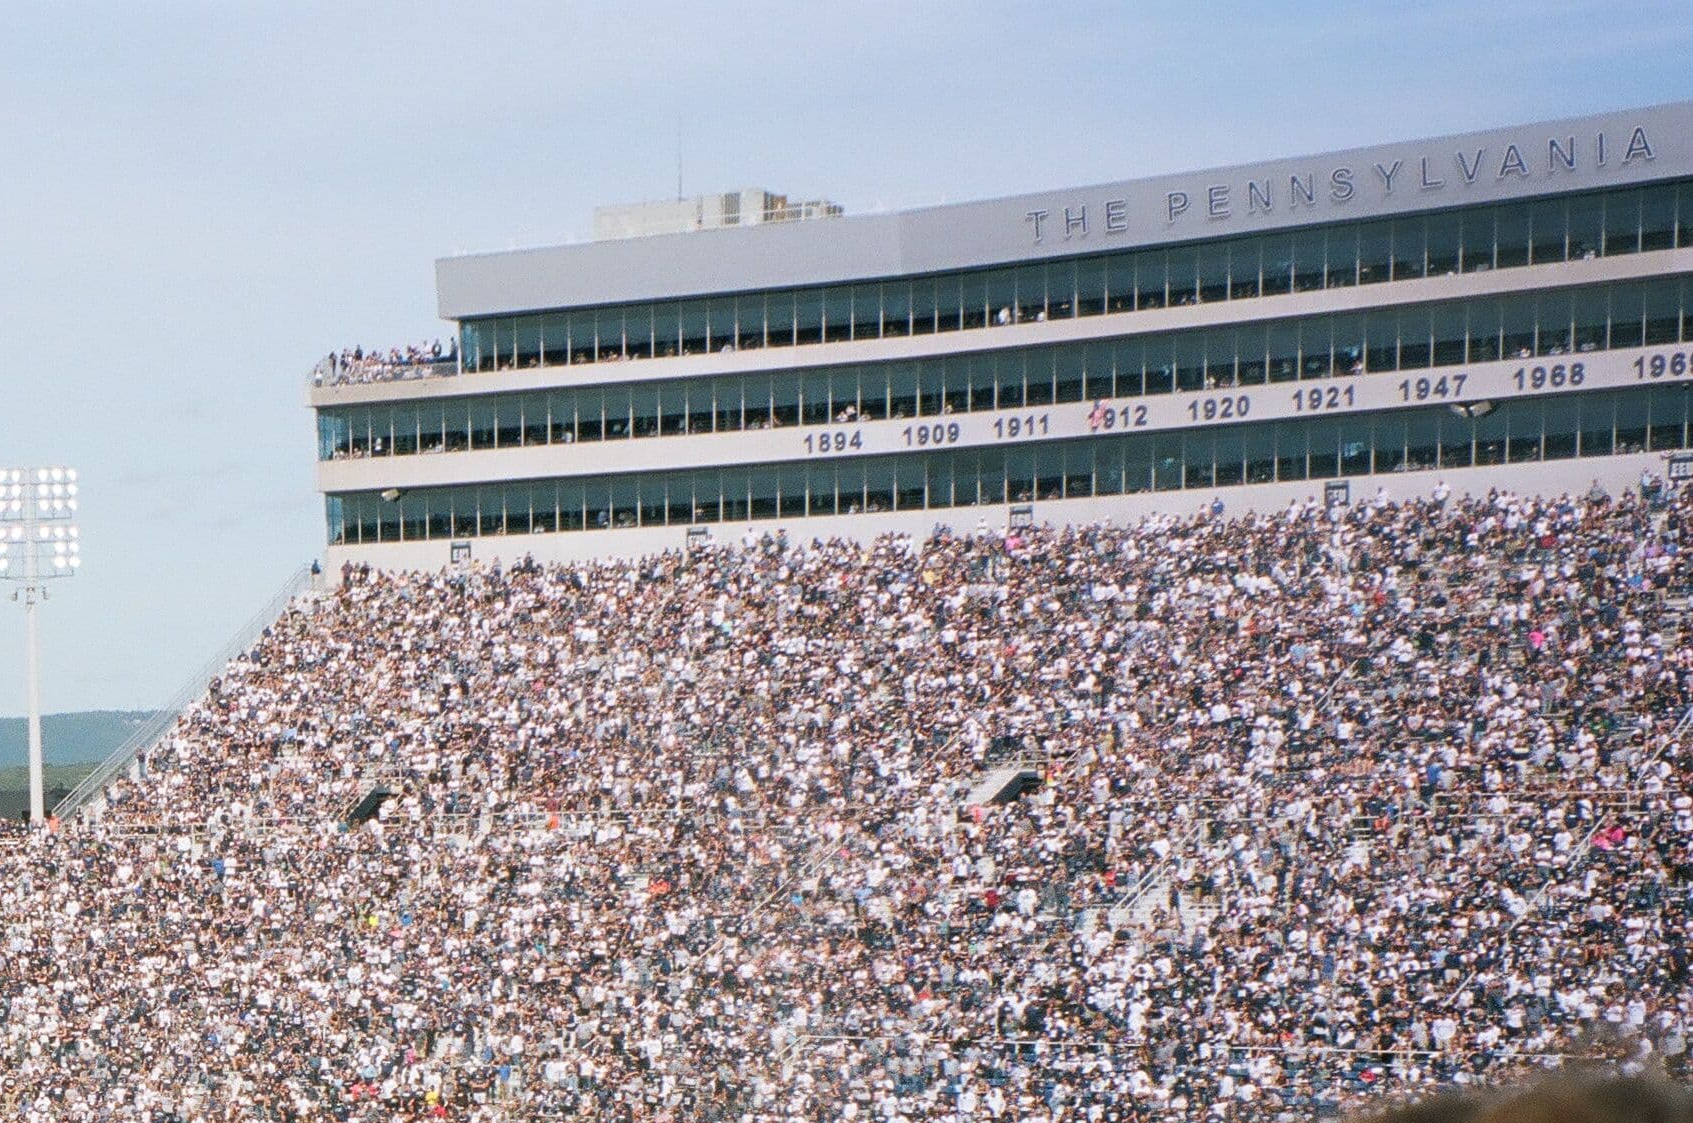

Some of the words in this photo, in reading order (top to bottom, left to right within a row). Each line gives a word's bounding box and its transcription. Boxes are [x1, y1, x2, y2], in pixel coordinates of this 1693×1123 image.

[1026, 199, 1128, 243] THE
[1166, 125, 1656, 226] PENNSYLVANIA
[1398, 374, 1468, 401] 1947
[1513, 362, 1585, 391] 1968
[1187, 395, 1250, 421] 1920
[1292, 385, 1356, 412] 1921
[903, 422, 961, 447] 1909
[994, 414, 1050, 439] 1911
[805, 430, 863, 455] 1894
